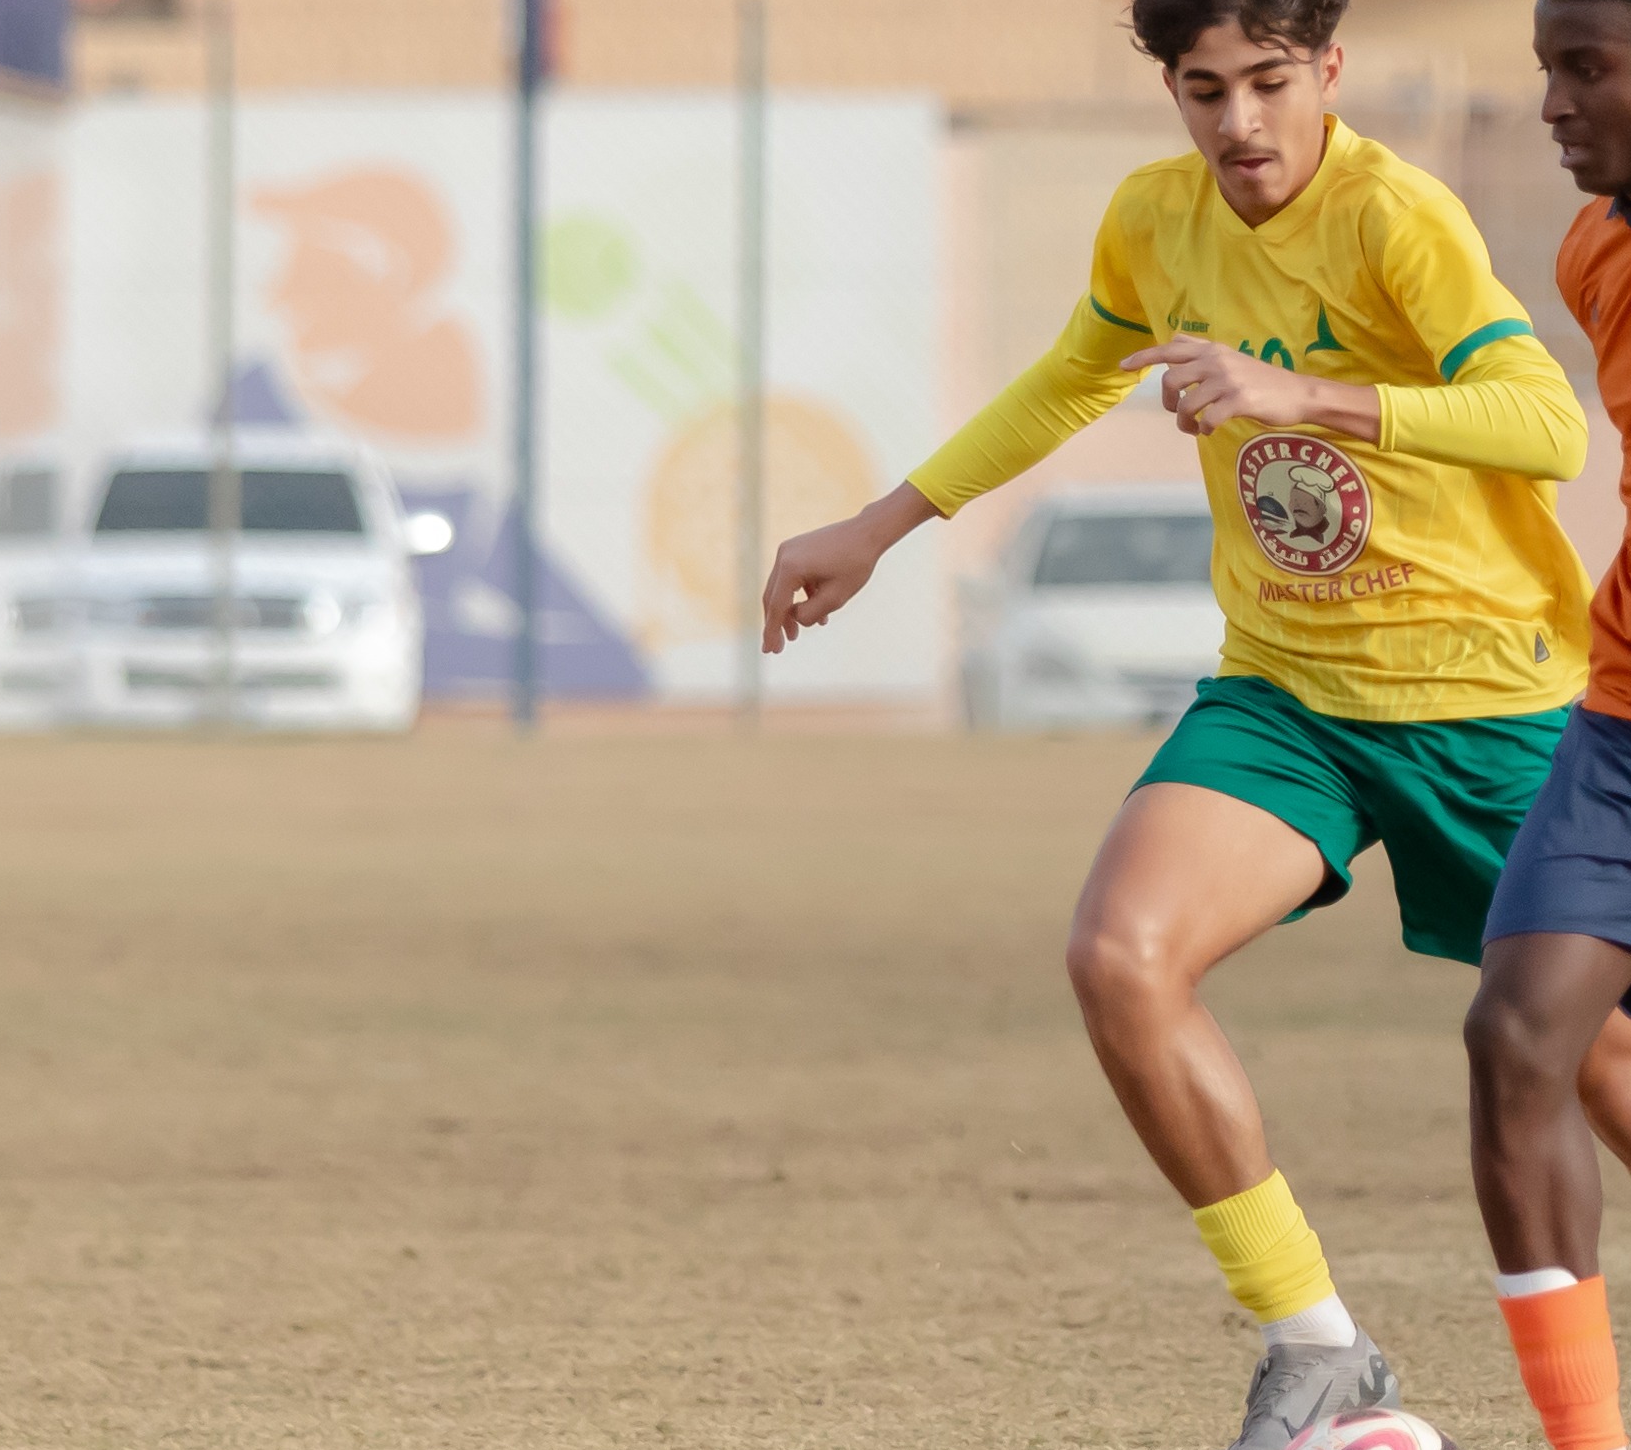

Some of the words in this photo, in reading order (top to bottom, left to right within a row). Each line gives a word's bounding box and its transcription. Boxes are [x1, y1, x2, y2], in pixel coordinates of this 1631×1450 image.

[1241, 442, 1293, 507] MASTER
[1299, 444, 1359, 494] CHEF
[1258, 580, 1344, 603] MASTER
[1350, 562, 1416, 597] CHEF
